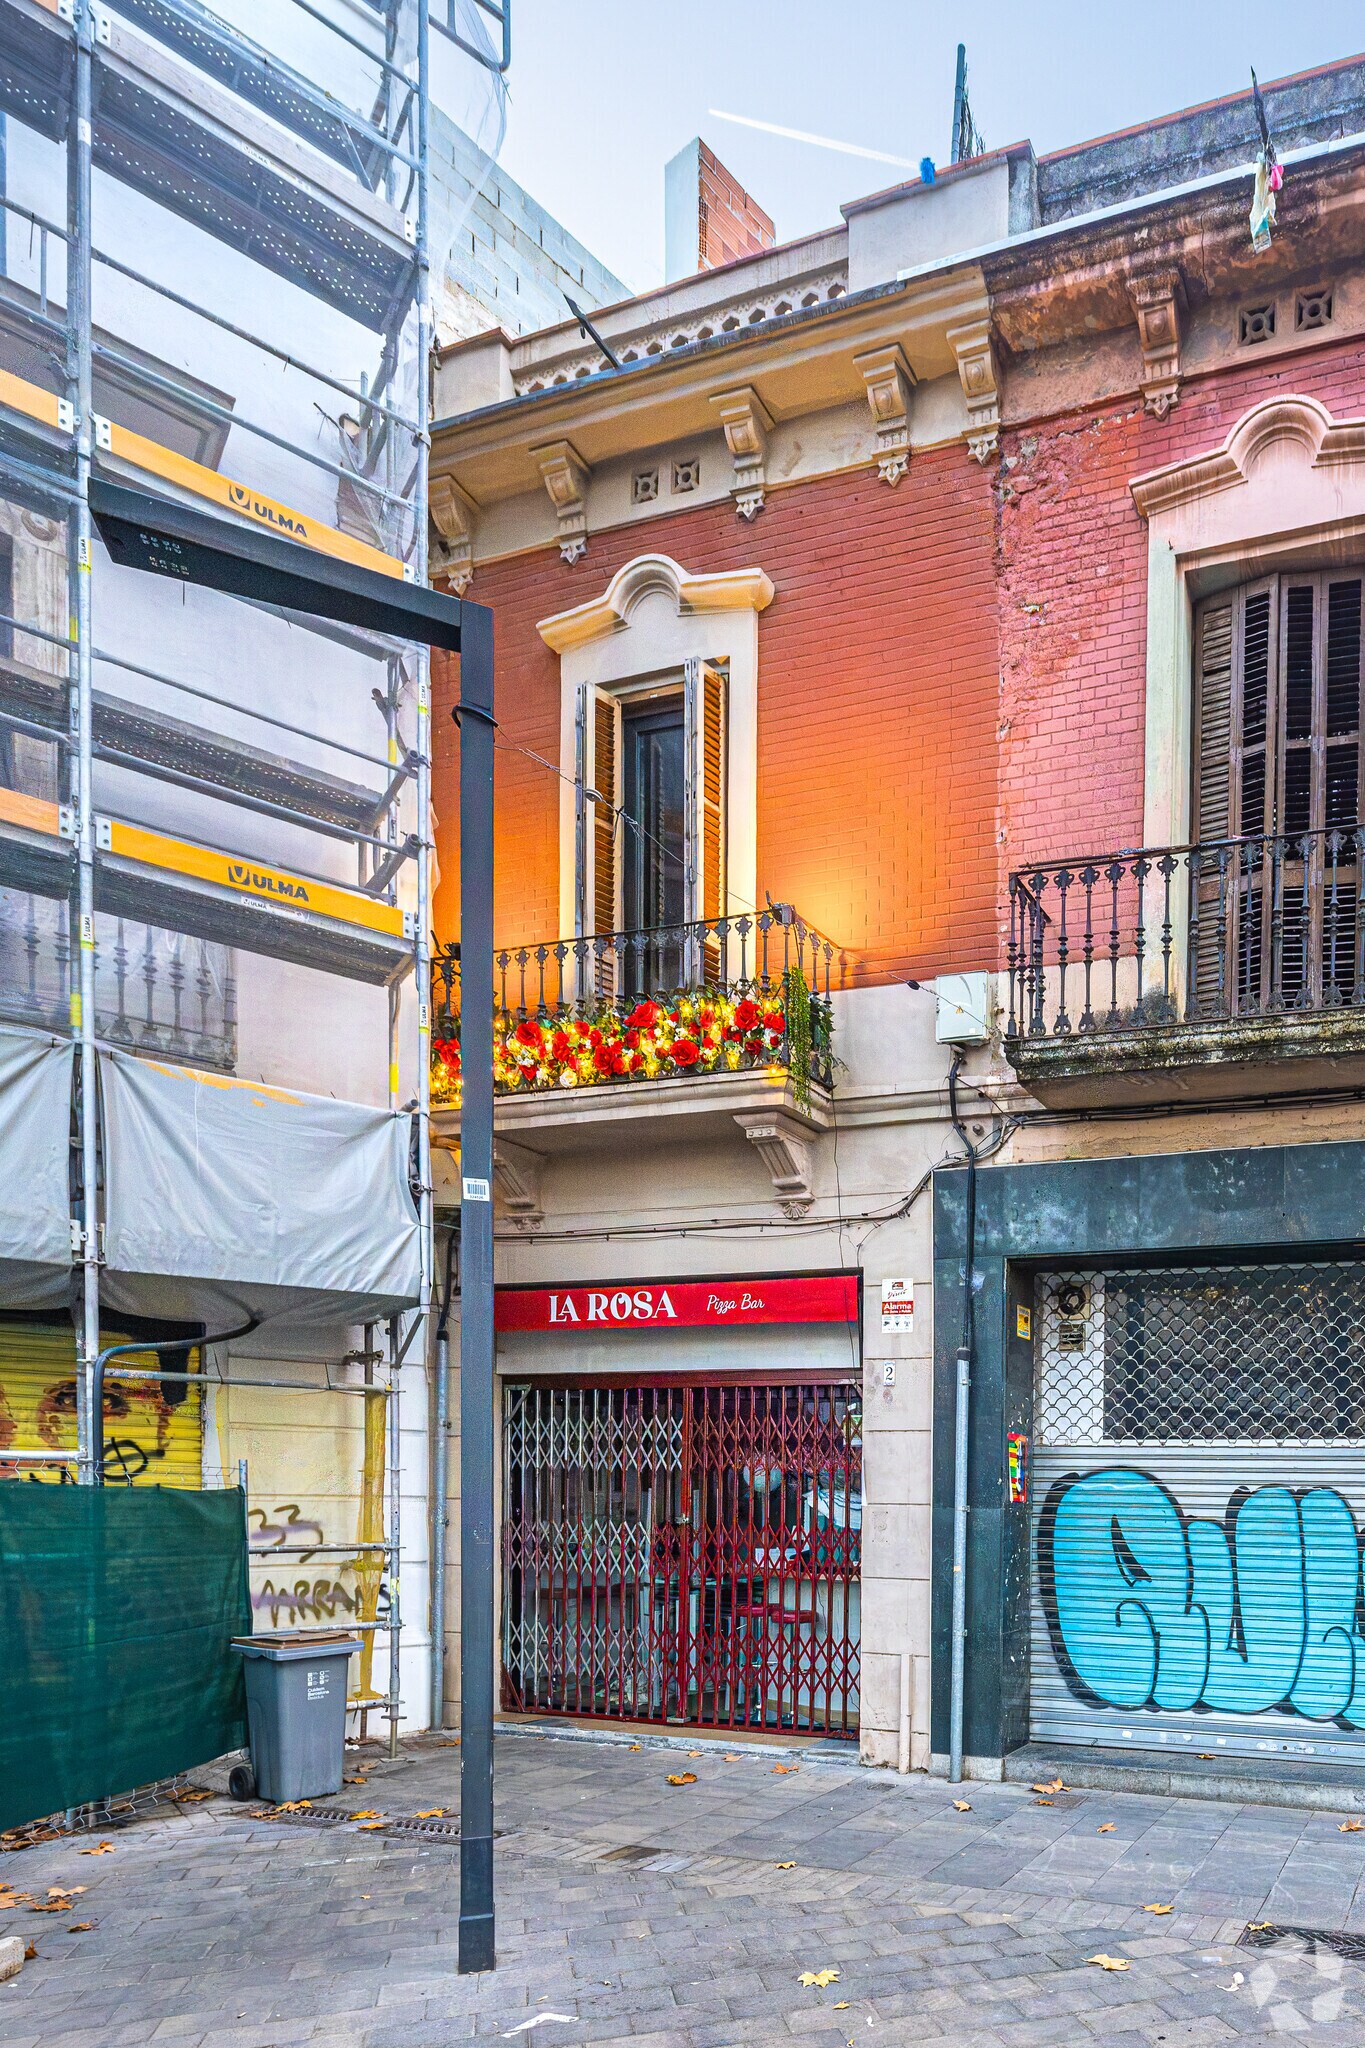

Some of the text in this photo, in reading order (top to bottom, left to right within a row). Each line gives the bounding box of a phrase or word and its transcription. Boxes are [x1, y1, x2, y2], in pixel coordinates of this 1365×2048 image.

[254, 501, 307, 538] ULMA
[252, 873, 309, 902] ULMA
[250, 900, 267, 910] ULMA
[548, 1290, 678, 1323] LA ROSA
[706, 1293, 765, 1315] Pizza Bar
[883, 1302, 912, 1311] Alarma
[885, 1366, 893, 1381] 2
